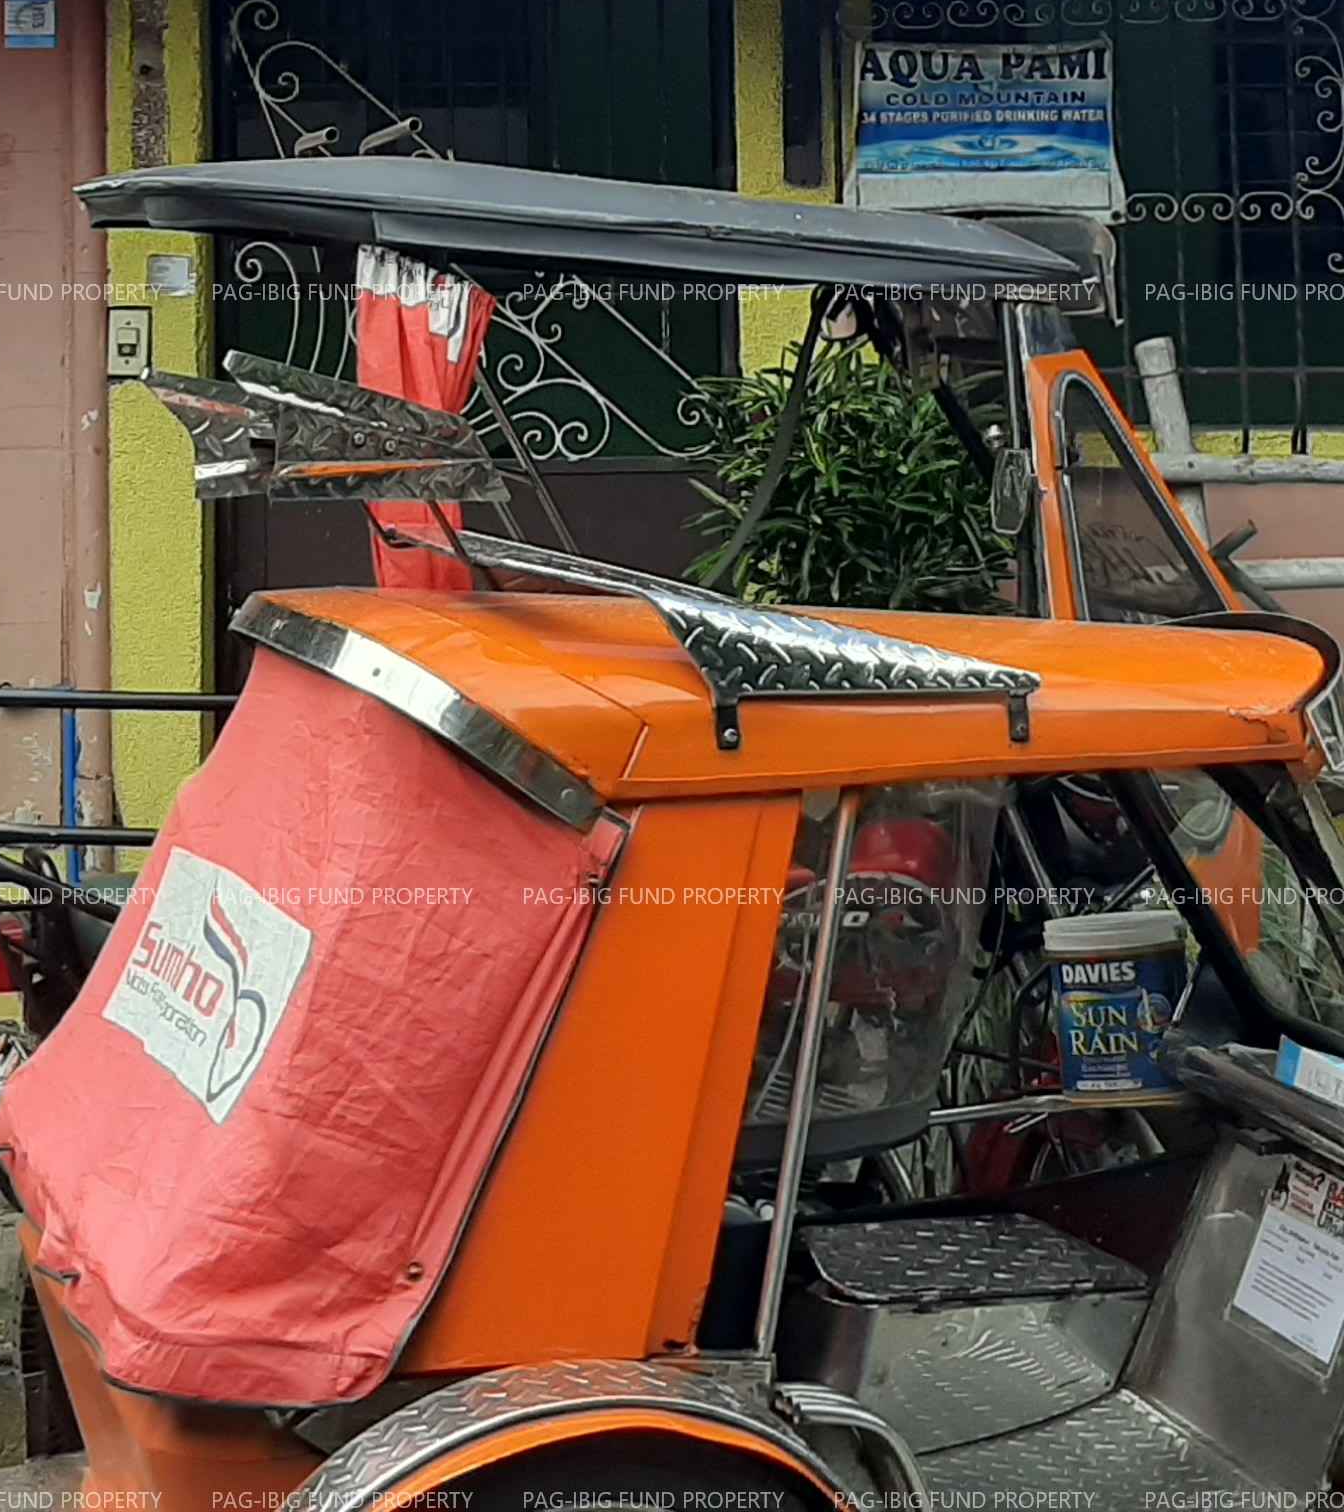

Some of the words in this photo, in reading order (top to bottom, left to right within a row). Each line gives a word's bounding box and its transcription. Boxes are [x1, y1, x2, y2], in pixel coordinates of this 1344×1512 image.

[859, 49, 985, 88] AQUA
[999, 47, 1107, 80] PAMI
[885, 92, 948, 106] COLD
[958, 91, 1086, 105] MOUNTAIN
[879, 111, 929, 123] STAGES
[932, 110, 992, 122] PURIFIED
[996, 109, 1059, 122] DRINKING
[1062, 108, 1105, 121] WATER
[1061, 960, 1136, 984] DAVIES
[1070, 1003, 1128, 1028] SUN
[1068, 1029, 1139, 1056] RAIN
